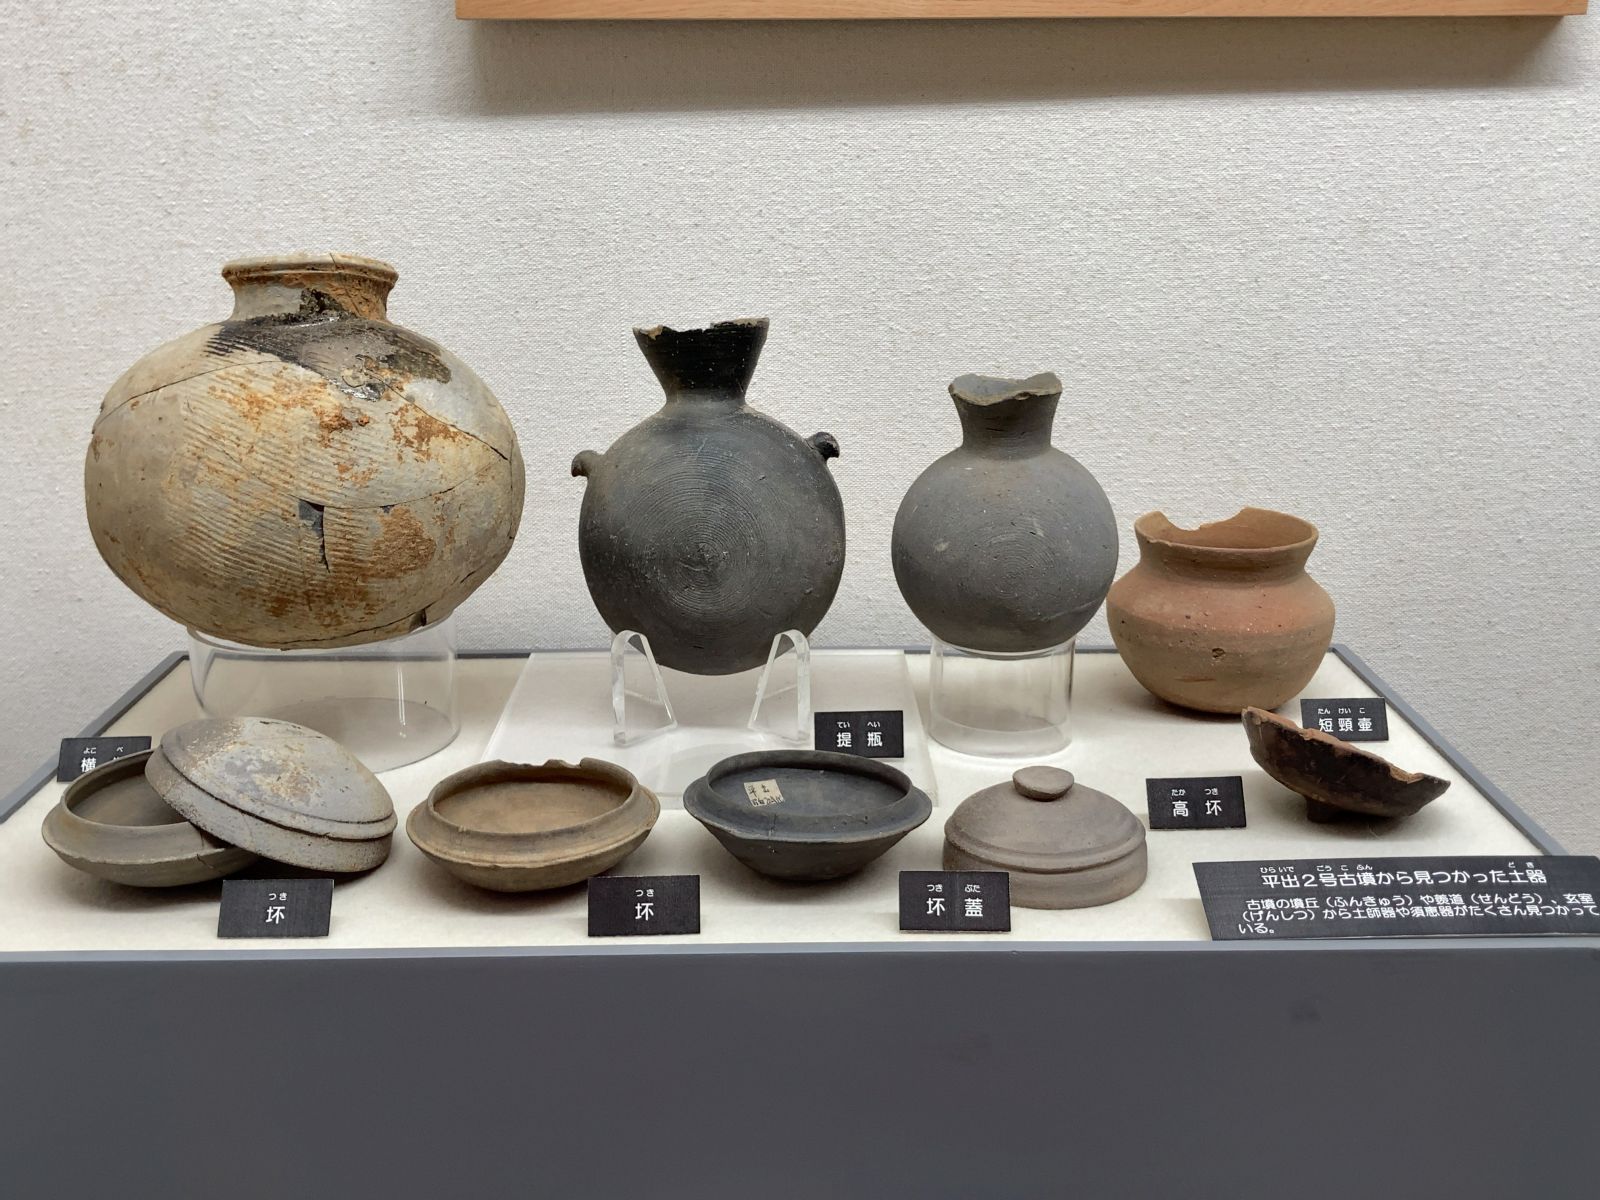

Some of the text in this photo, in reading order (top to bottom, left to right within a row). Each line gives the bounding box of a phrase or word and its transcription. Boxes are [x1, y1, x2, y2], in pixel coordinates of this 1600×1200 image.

[836, 721, 851, 729] てい
[836, 731, 884, 748] 提瓶
[1171, 787, 1219, 797] たか つき
[1171, 800, 1223, 818] 高坏
[635, 888, 655, 897] つき
[926, 883, 981, 893] つき ぶた
[268, 892, 288, 901] つき
[634, 902, 655, 921] 坏
[926, 897, 984, 917] 坏蓋
[265, 905, 286, 925] 坏
[1238, 922, 1276, 934] いる。
